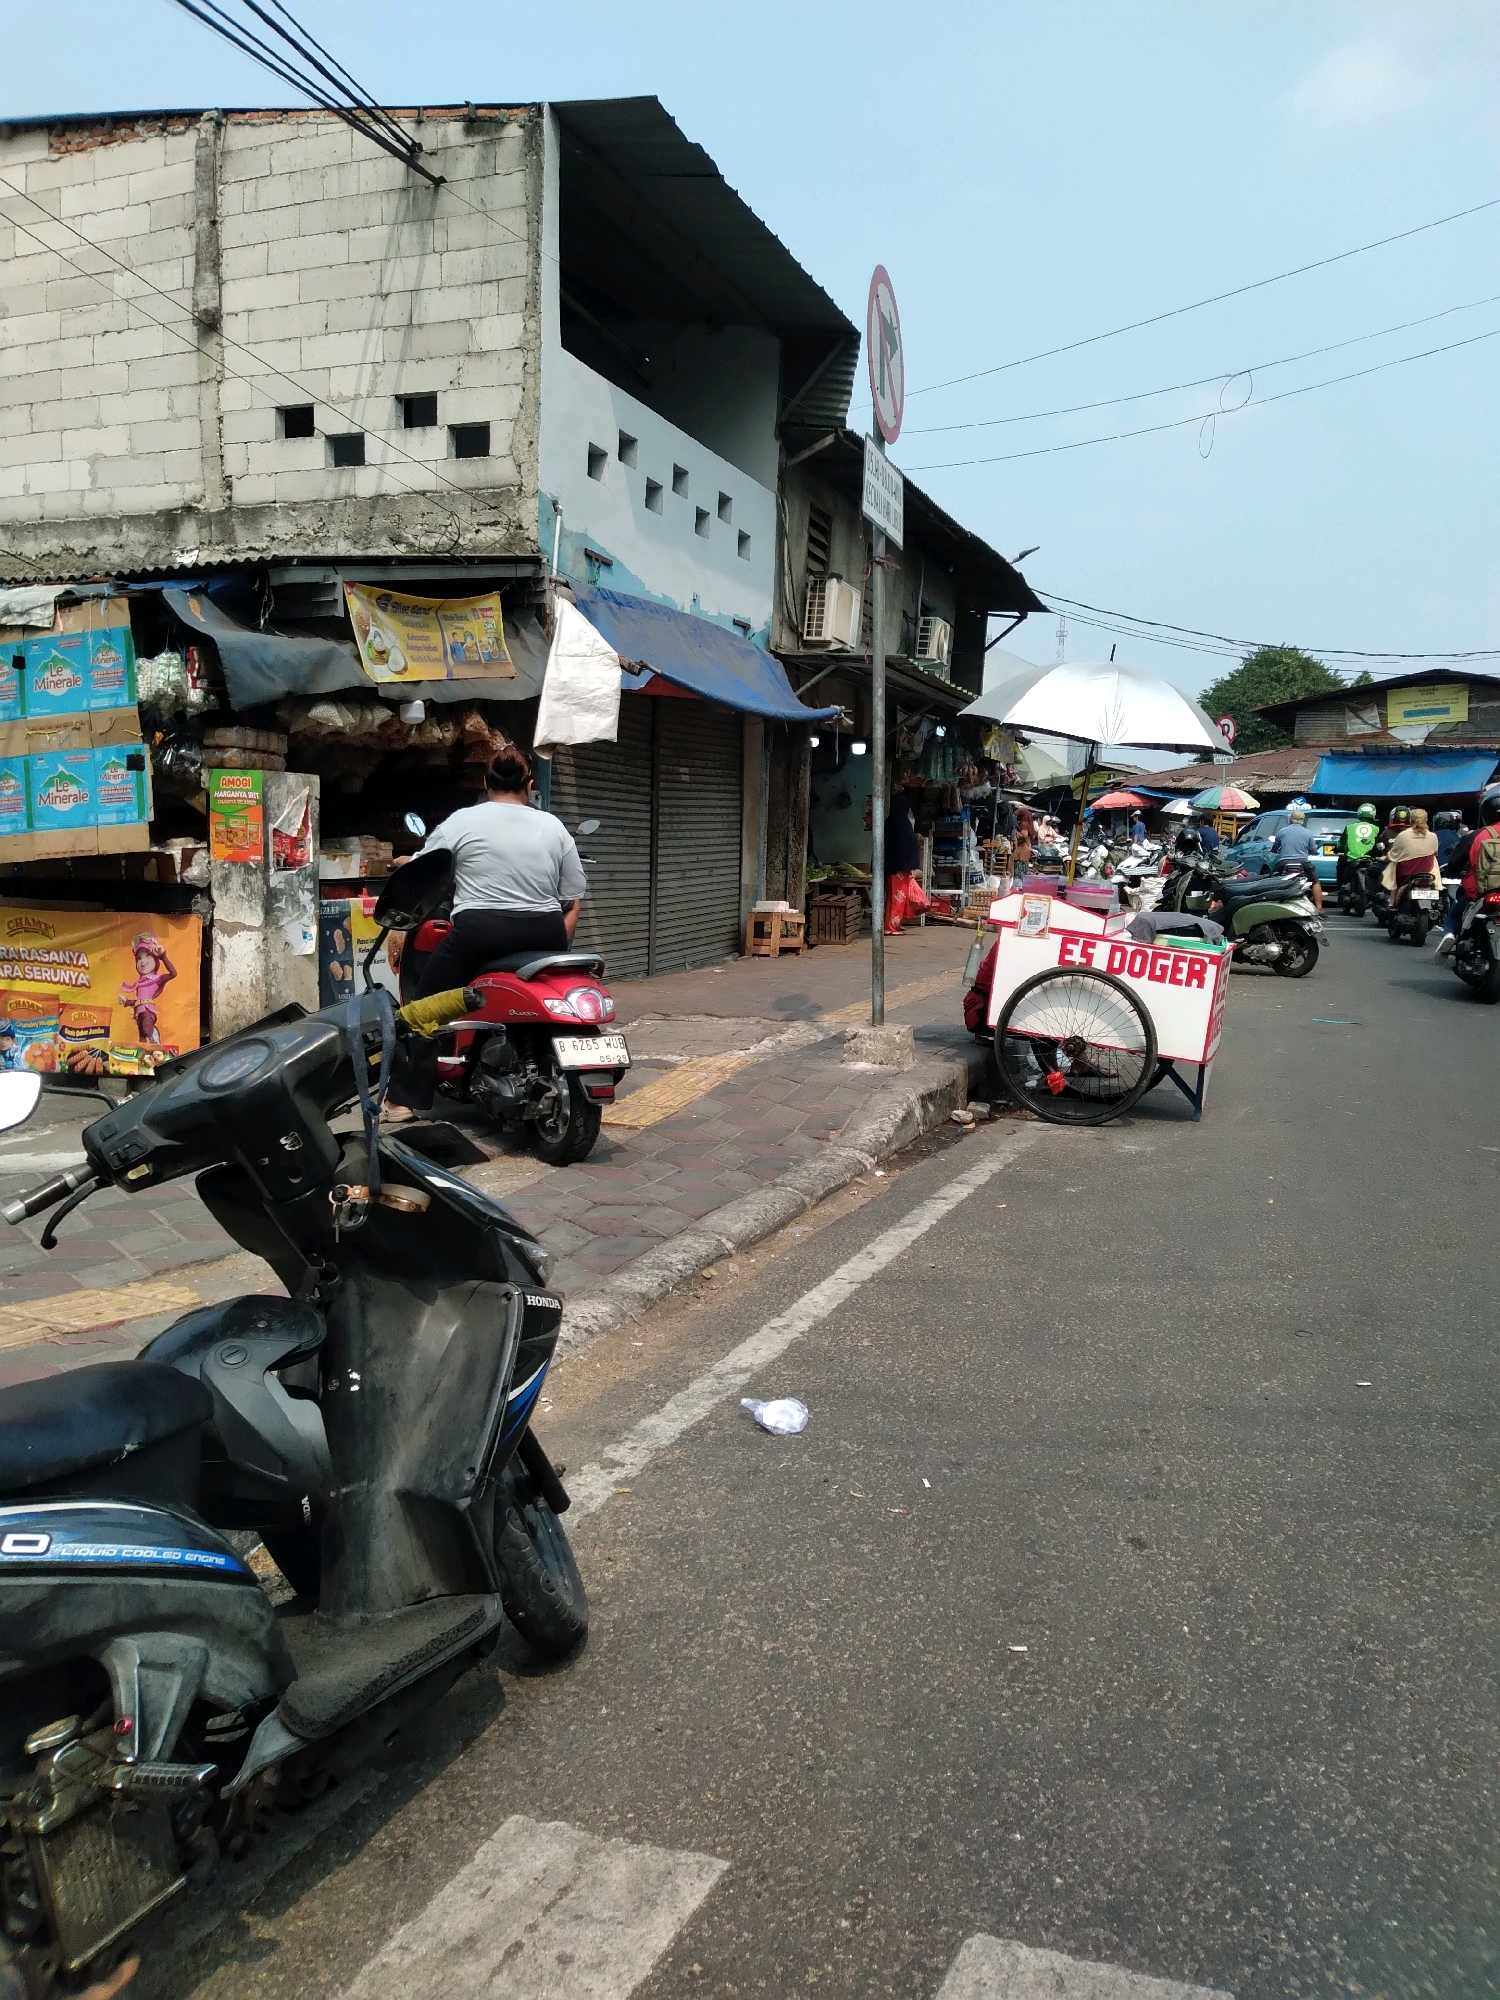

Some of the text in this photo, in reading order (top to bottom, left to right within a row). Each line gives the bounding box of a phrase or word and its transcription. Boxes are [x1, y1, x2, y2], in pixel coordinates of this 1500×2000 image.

[49, 663, 64, 677] Le
[34, 673, 82, 691] Minerale
[55, 779, 69, 793] Le
[221, 777, 251, 789] AMOGI
[38, 792, 89, 807] Minerale
[20, 948, 89, 967] RASANYA
[1057, 936, 1208, 989] ES DOGER
[25, 966, 90, 987] SERUNYA
[558, 1037, 625, 1052] B 6265 WUB
[525, 1295, 562, 1309] HONDA
[121, 1549, 182, 1560] COOLED
